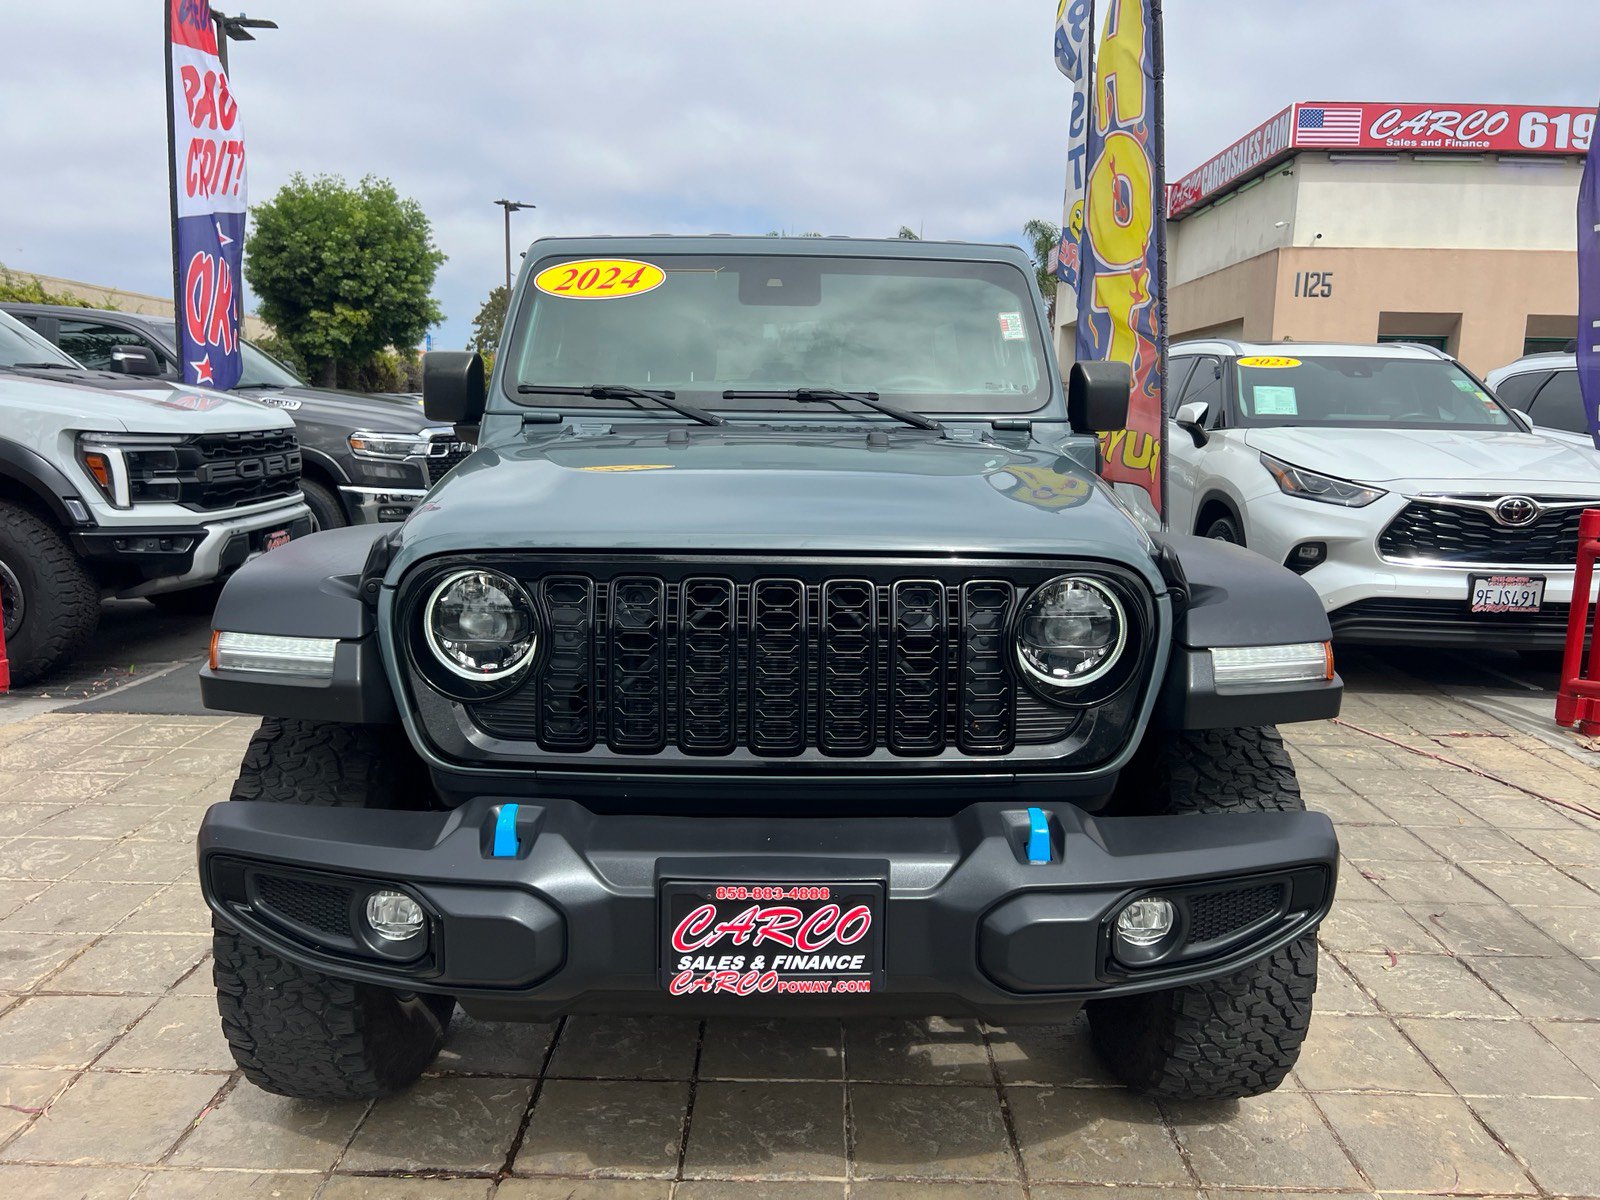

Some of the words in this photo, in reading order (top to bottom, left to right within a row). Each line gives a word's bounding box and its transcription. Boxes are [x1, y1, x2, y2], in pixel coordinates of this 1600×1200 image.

[1369, 108, 1510, 142] CARCO
[1201, 111, 1291, 197] CARCOSALES.COM
[1386, 138, 1417, 147] Sales
[1420, 139, 1442, 147] and
[1445, 139, 1490, 148] Finance
[553, 266, 647, 291] 2024
[1294, 272, 1333, 298] 1125
[200, 452, 302, 482] FORD
[1475, 589, 1538, 607] 9EJS491
[715, 886, 831, 901] 858-883-4888
[671, 903, 872, 953] CARCO
[677, 955, 746, 971] SALES
[750, 955, 766, 971] &
[771, 955, 866, 971] FINANCE
